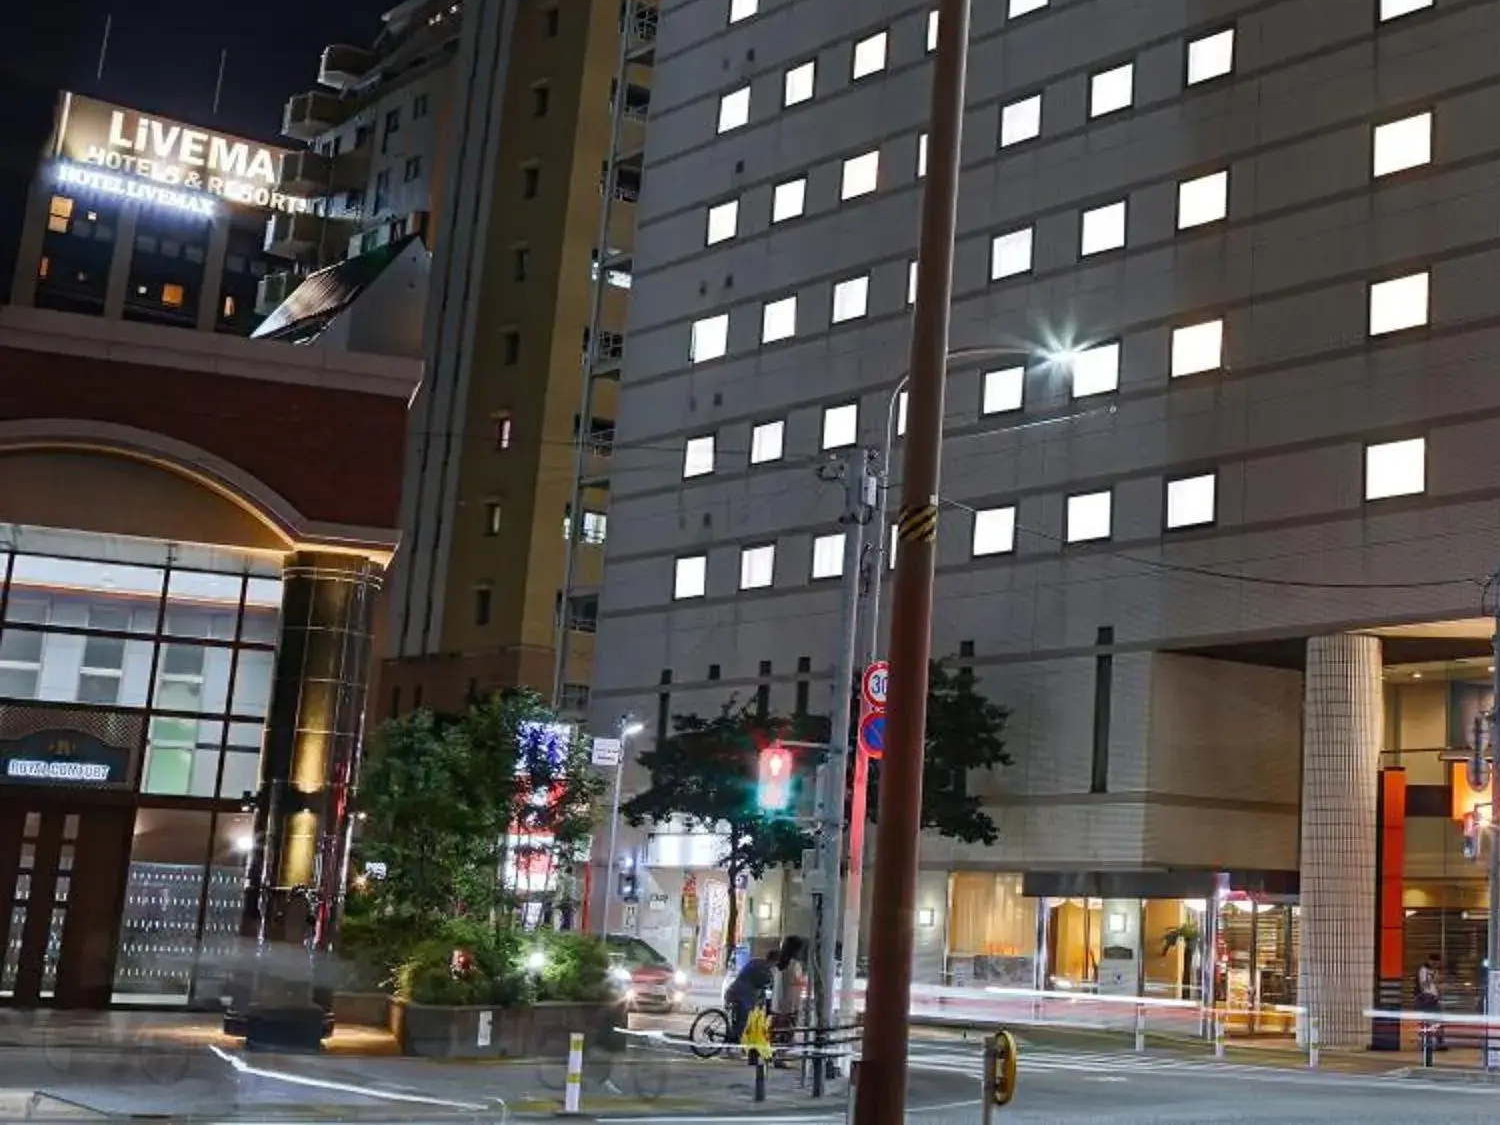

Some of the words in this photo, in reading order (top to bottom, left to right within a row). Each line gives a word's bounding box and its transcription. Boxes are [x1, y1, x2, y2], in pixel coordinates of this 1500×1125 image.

[86, 146, 179, 184] HOTELS
[187, 170, 203, 189] &
[108, 110, 277, 184] LiVEMA
[59, 165, 124, 194] HOTEL
